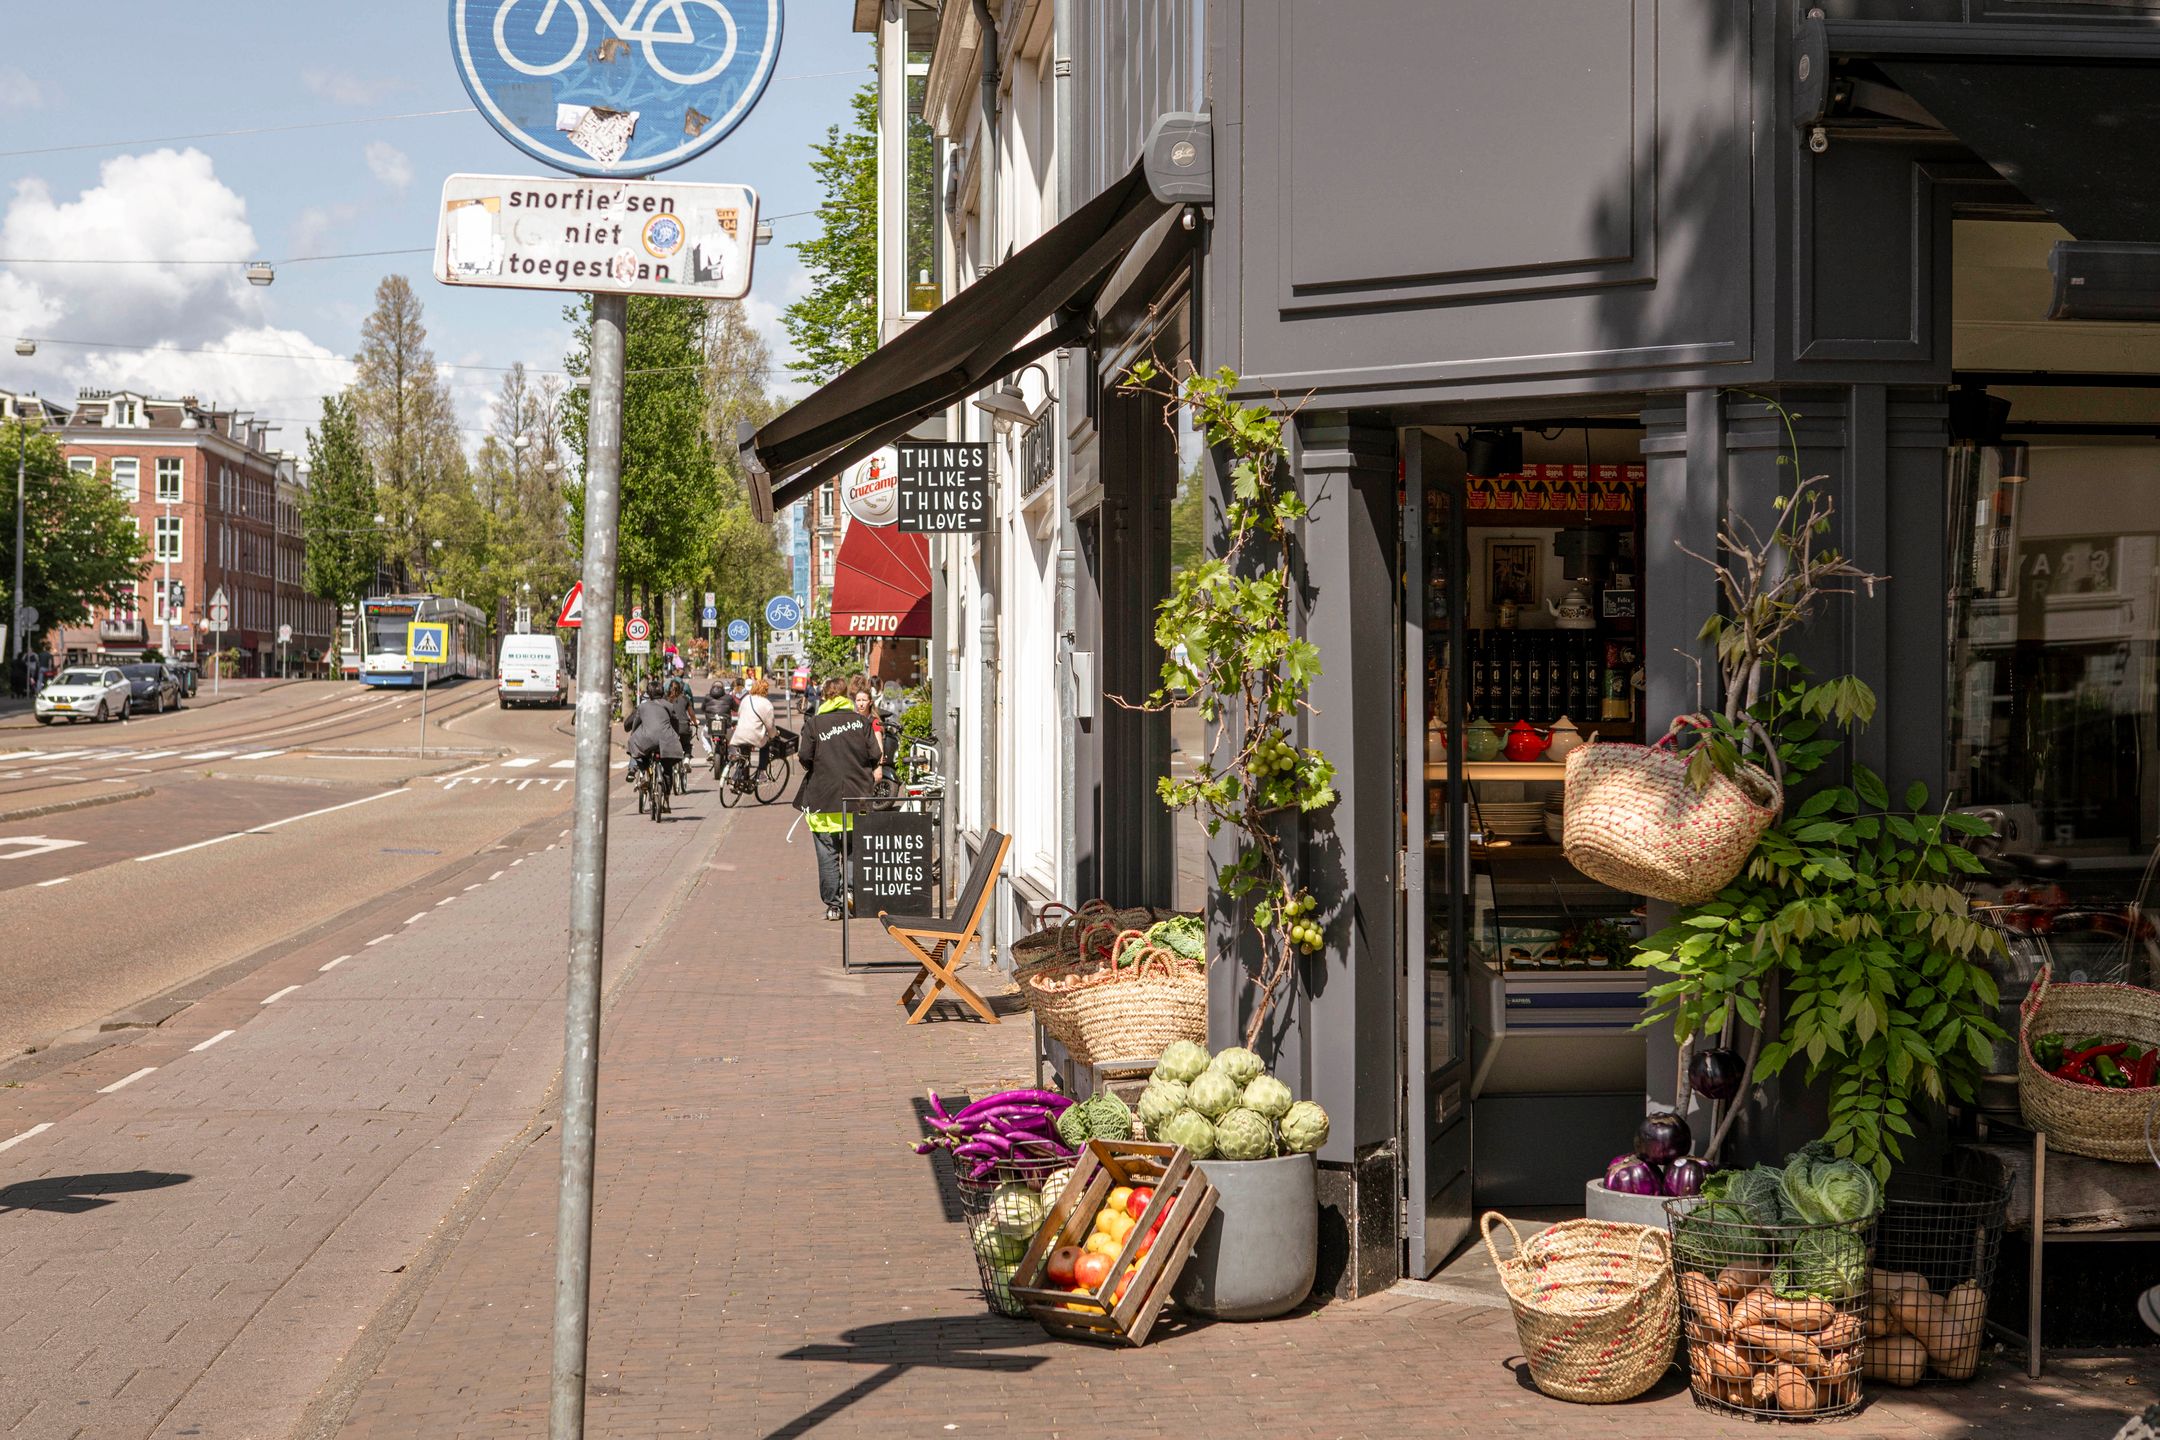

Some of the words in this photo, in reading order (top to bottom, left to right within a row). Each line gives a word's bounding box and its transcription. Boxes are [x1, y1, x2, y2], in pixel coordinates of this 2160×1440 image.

[509, 189, 674, 214] snorfiesen
[565, 224, 622, 245] niet
[509, 253, 670, 282] toegestan
[902, 448, 983, 468] THINGS
[928, 471, 966, 487] LIKE
[850, 475, 898, 500] Cruzcamp
[902, 491, 983, 511] THINGS
[928, 513, 967, 530] LOVE
[631, 625, 645, 634] 30
[849, 615, 898, 631] PEPITO
[863, 835, 924, 850] THINGS
[882, 852, 911, 864] LIKE
[863, 866, 923, 881] THINGS
[882, 883, 912, 896] LOVE
